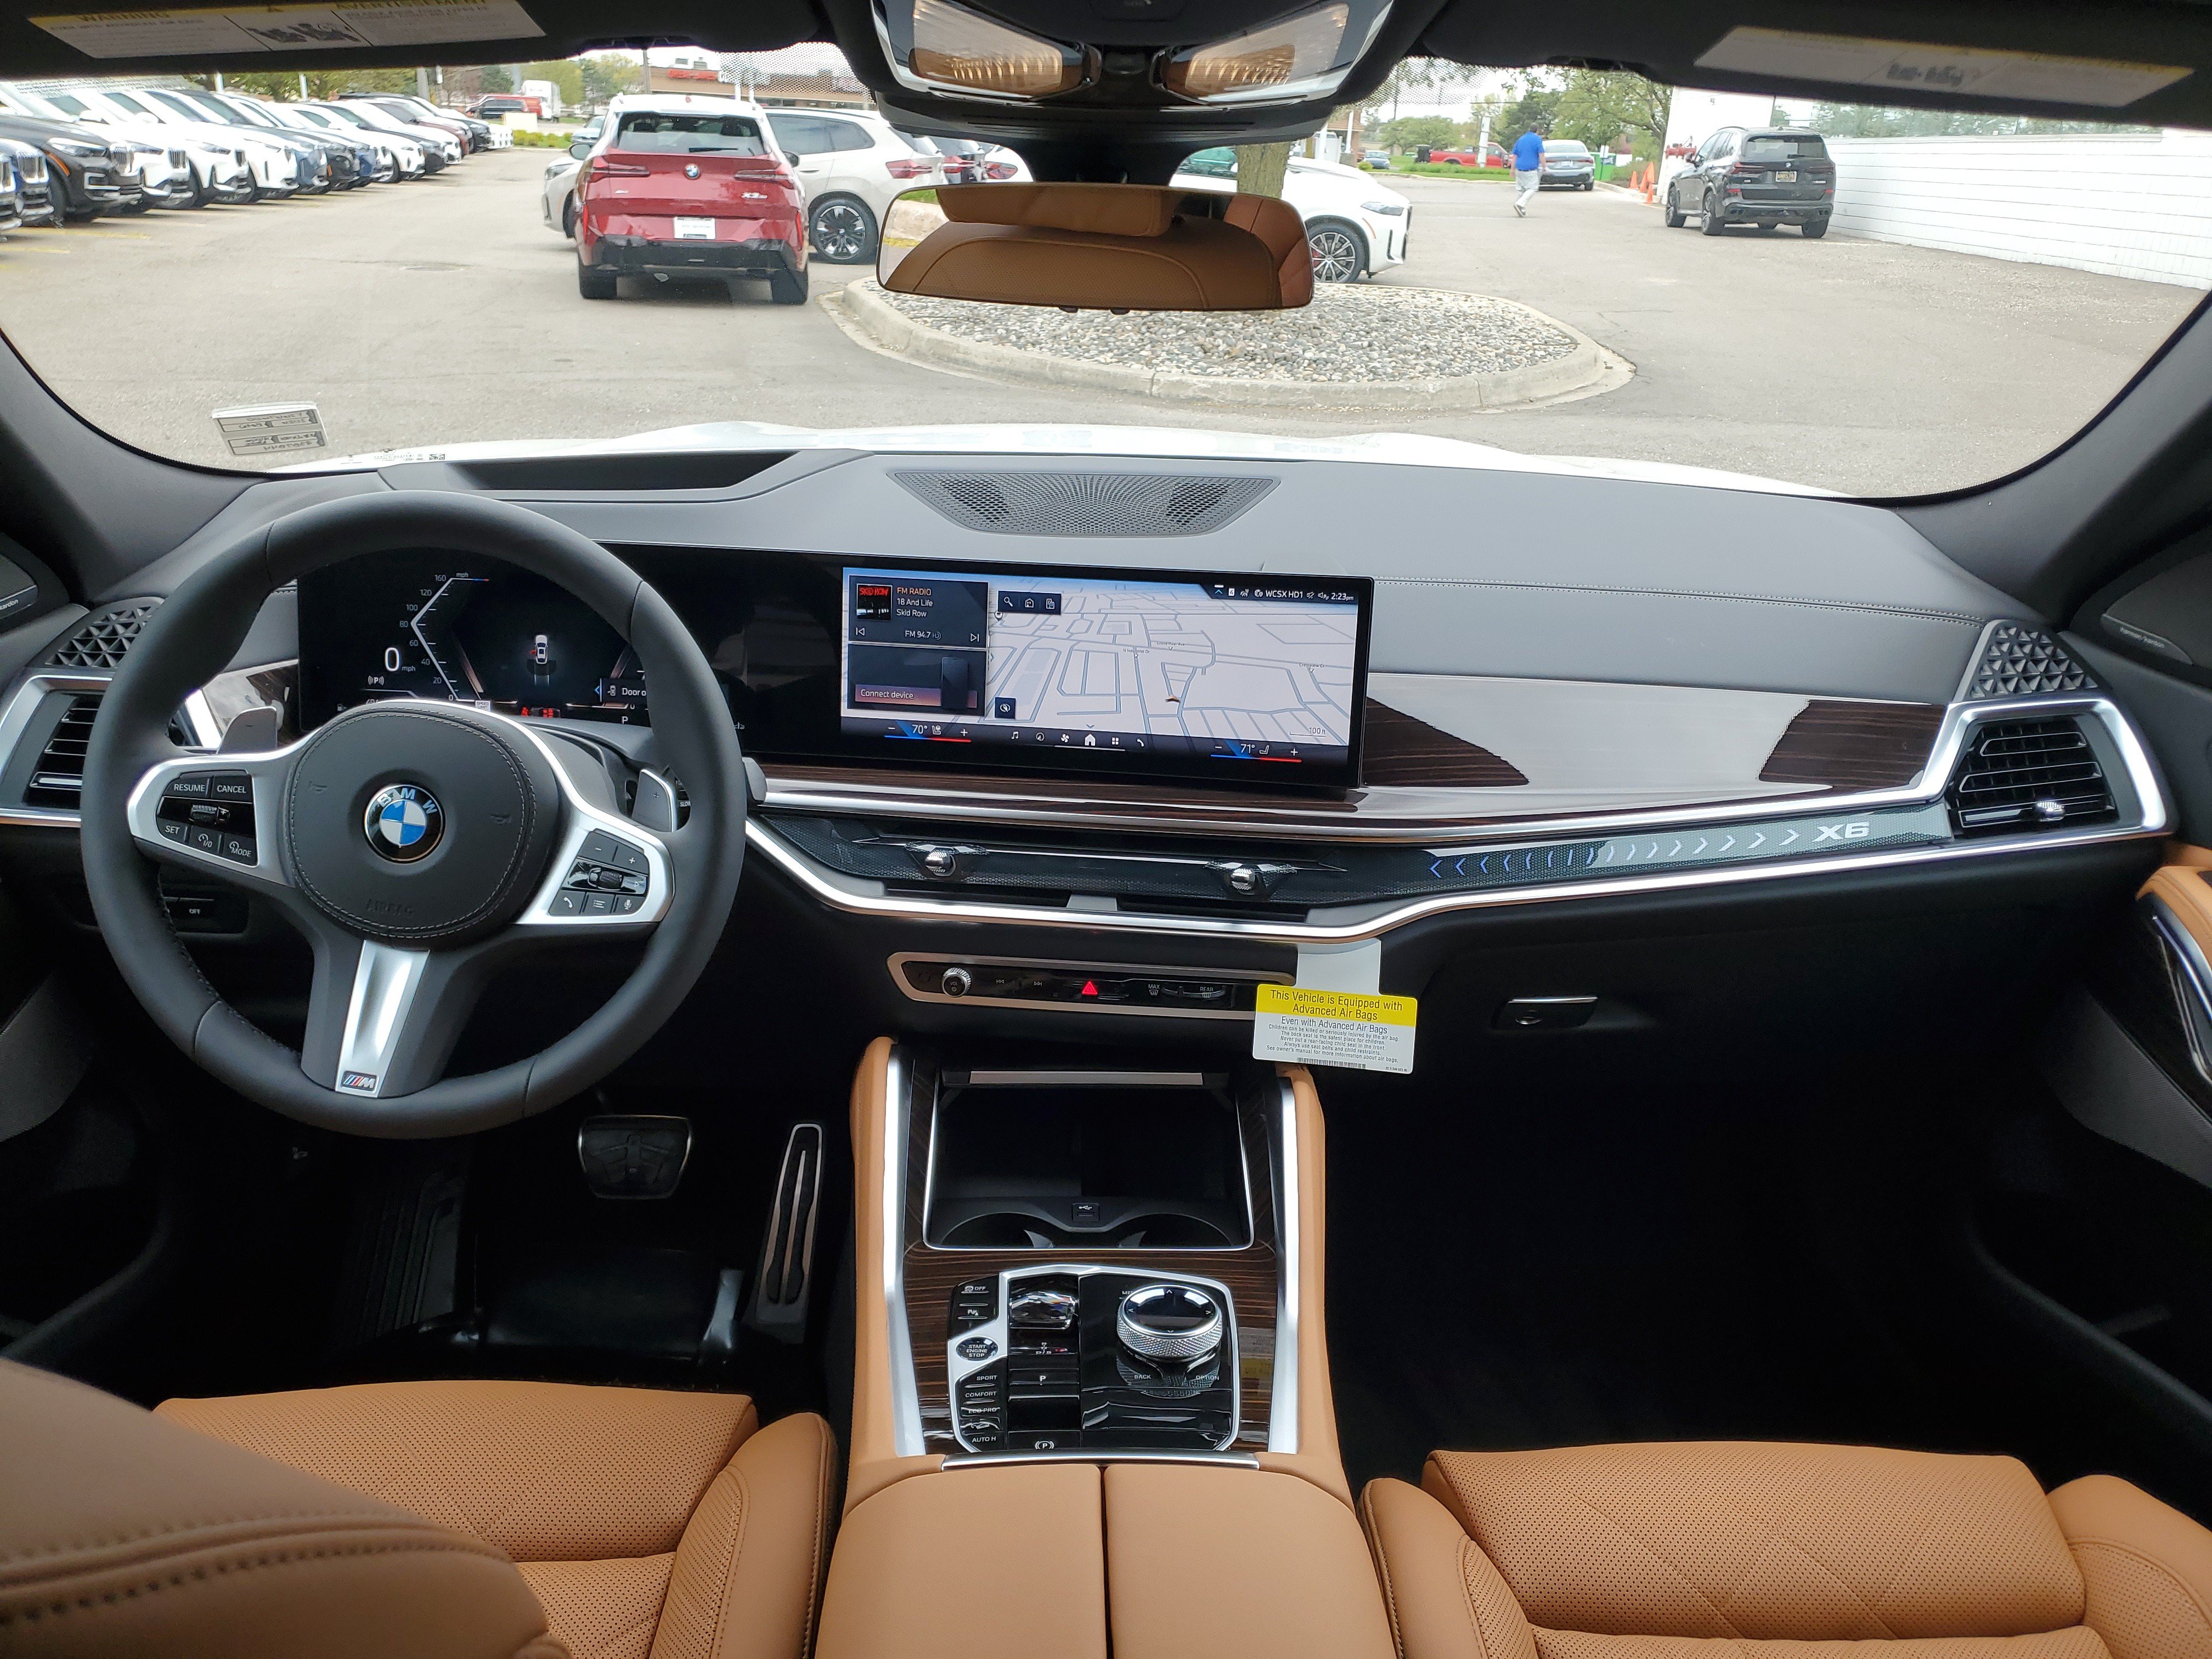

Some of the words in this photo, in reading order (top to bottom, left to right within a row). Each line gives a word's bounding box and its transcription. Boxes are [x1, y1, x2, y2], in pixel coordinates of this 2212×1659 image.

[1265, 590, 1288, 598] WCSX
[896, 608, 911, 617] Skid
[385, 647, 400, 672] 0
[622, 687, 640, 696] Door
[860, 689, 890, 698] Connect
[891, 691, 914, 699] device
[622, 716, 628, 724] P
[912, 725, 928, 734] 70°
[1240, 743, 1255, 754] 71°
[174, 783, 206, 792] RESUME
[217, 785, 246, 793] CANCEL
[377, 788, 438, 815] BMW
[165, 825, 180, 834] SET
[1812, 822, 1870, 842] X6
[231, 848, 252, 857] MODE
[1271, 990, 1289, 1000] This
[1292, 991, 1324, 1003] Vehicle
[1327, 995, 1335, 1005] is
[1338, 996, 1380, 1009] Equipped
[1383, 1001, 1403, 1011] with
[1293, 1003, 1336, 1017] Advanced
[1339, 1007, 1353, 1018] Air
[1356, 1009, 1378, 1022] Bags
[1281, 1016, 1299, 1025] Even
[1301, 1018, 1316, 1027] with
[1318, 1019, 1354, 1030] Advanced
[1356, 1023, 1367, 1032] Air
[1369, 1024, 1387, 1035] Bags
